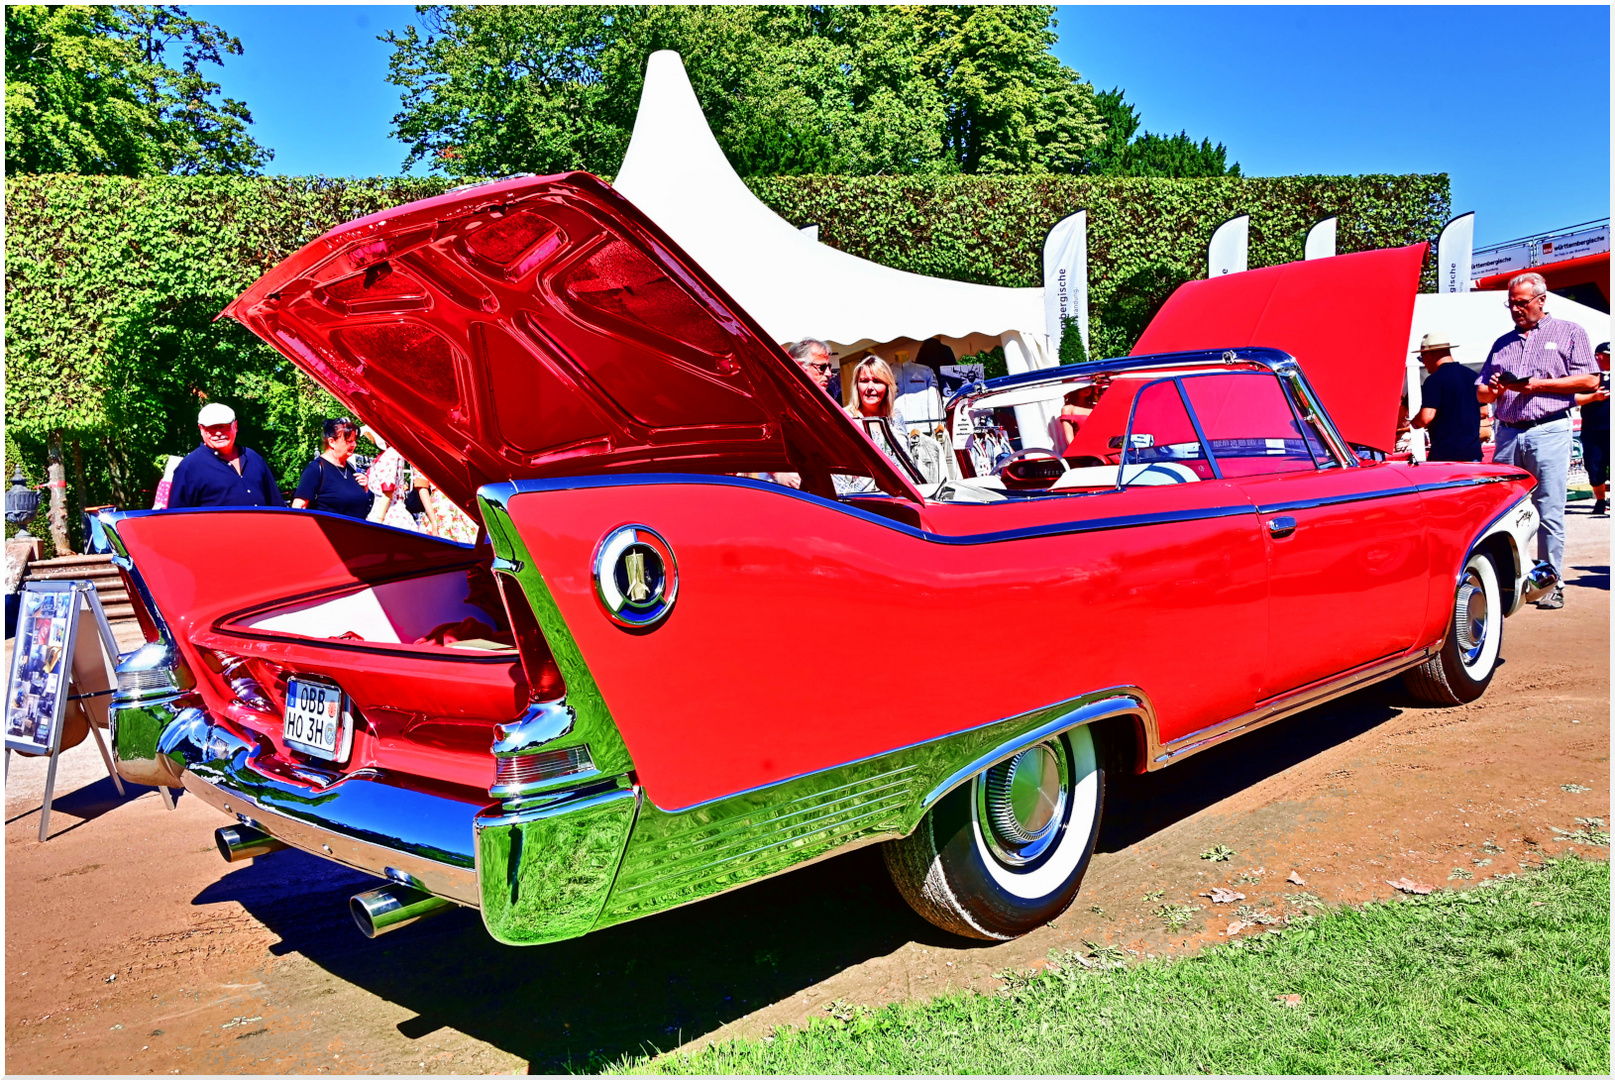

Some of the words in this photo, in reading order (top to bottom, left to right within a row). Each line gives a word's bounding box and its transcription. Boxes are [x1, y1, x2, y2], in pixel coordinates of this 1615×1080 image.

[1554, 237, 1604, 250] württembergische
[301, 687, 325, 715] OBB
[287, 711, 303, 738] HO
[307, 717, 324, 744] 3H
